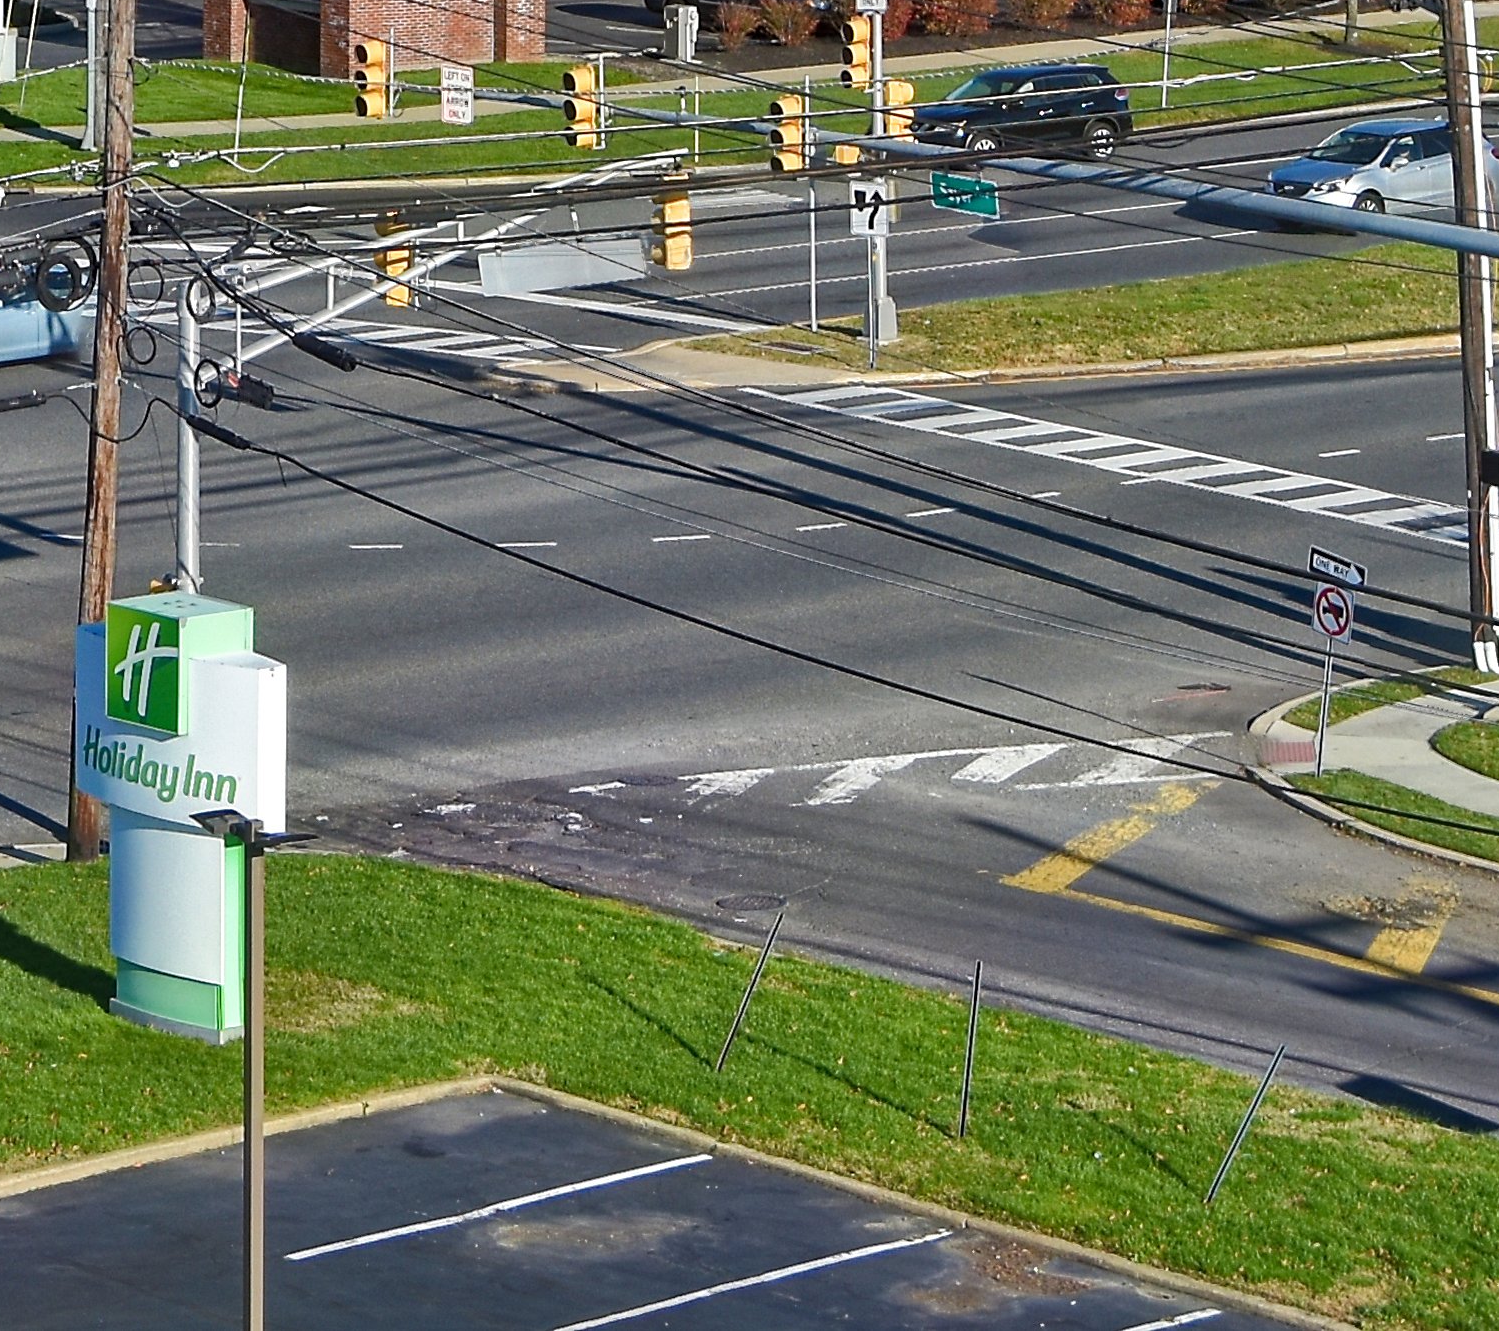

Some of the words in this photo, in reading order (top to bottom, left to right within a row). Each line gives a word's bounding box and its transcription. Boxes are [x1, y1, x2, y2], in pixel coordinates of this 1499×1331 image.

[1315, 556, 1330, 571] ONE
[1333, 564, 1350, 578] WAY
[83, 724, 180, 803] Holiday
[183, 754, 237, 804] Inn
